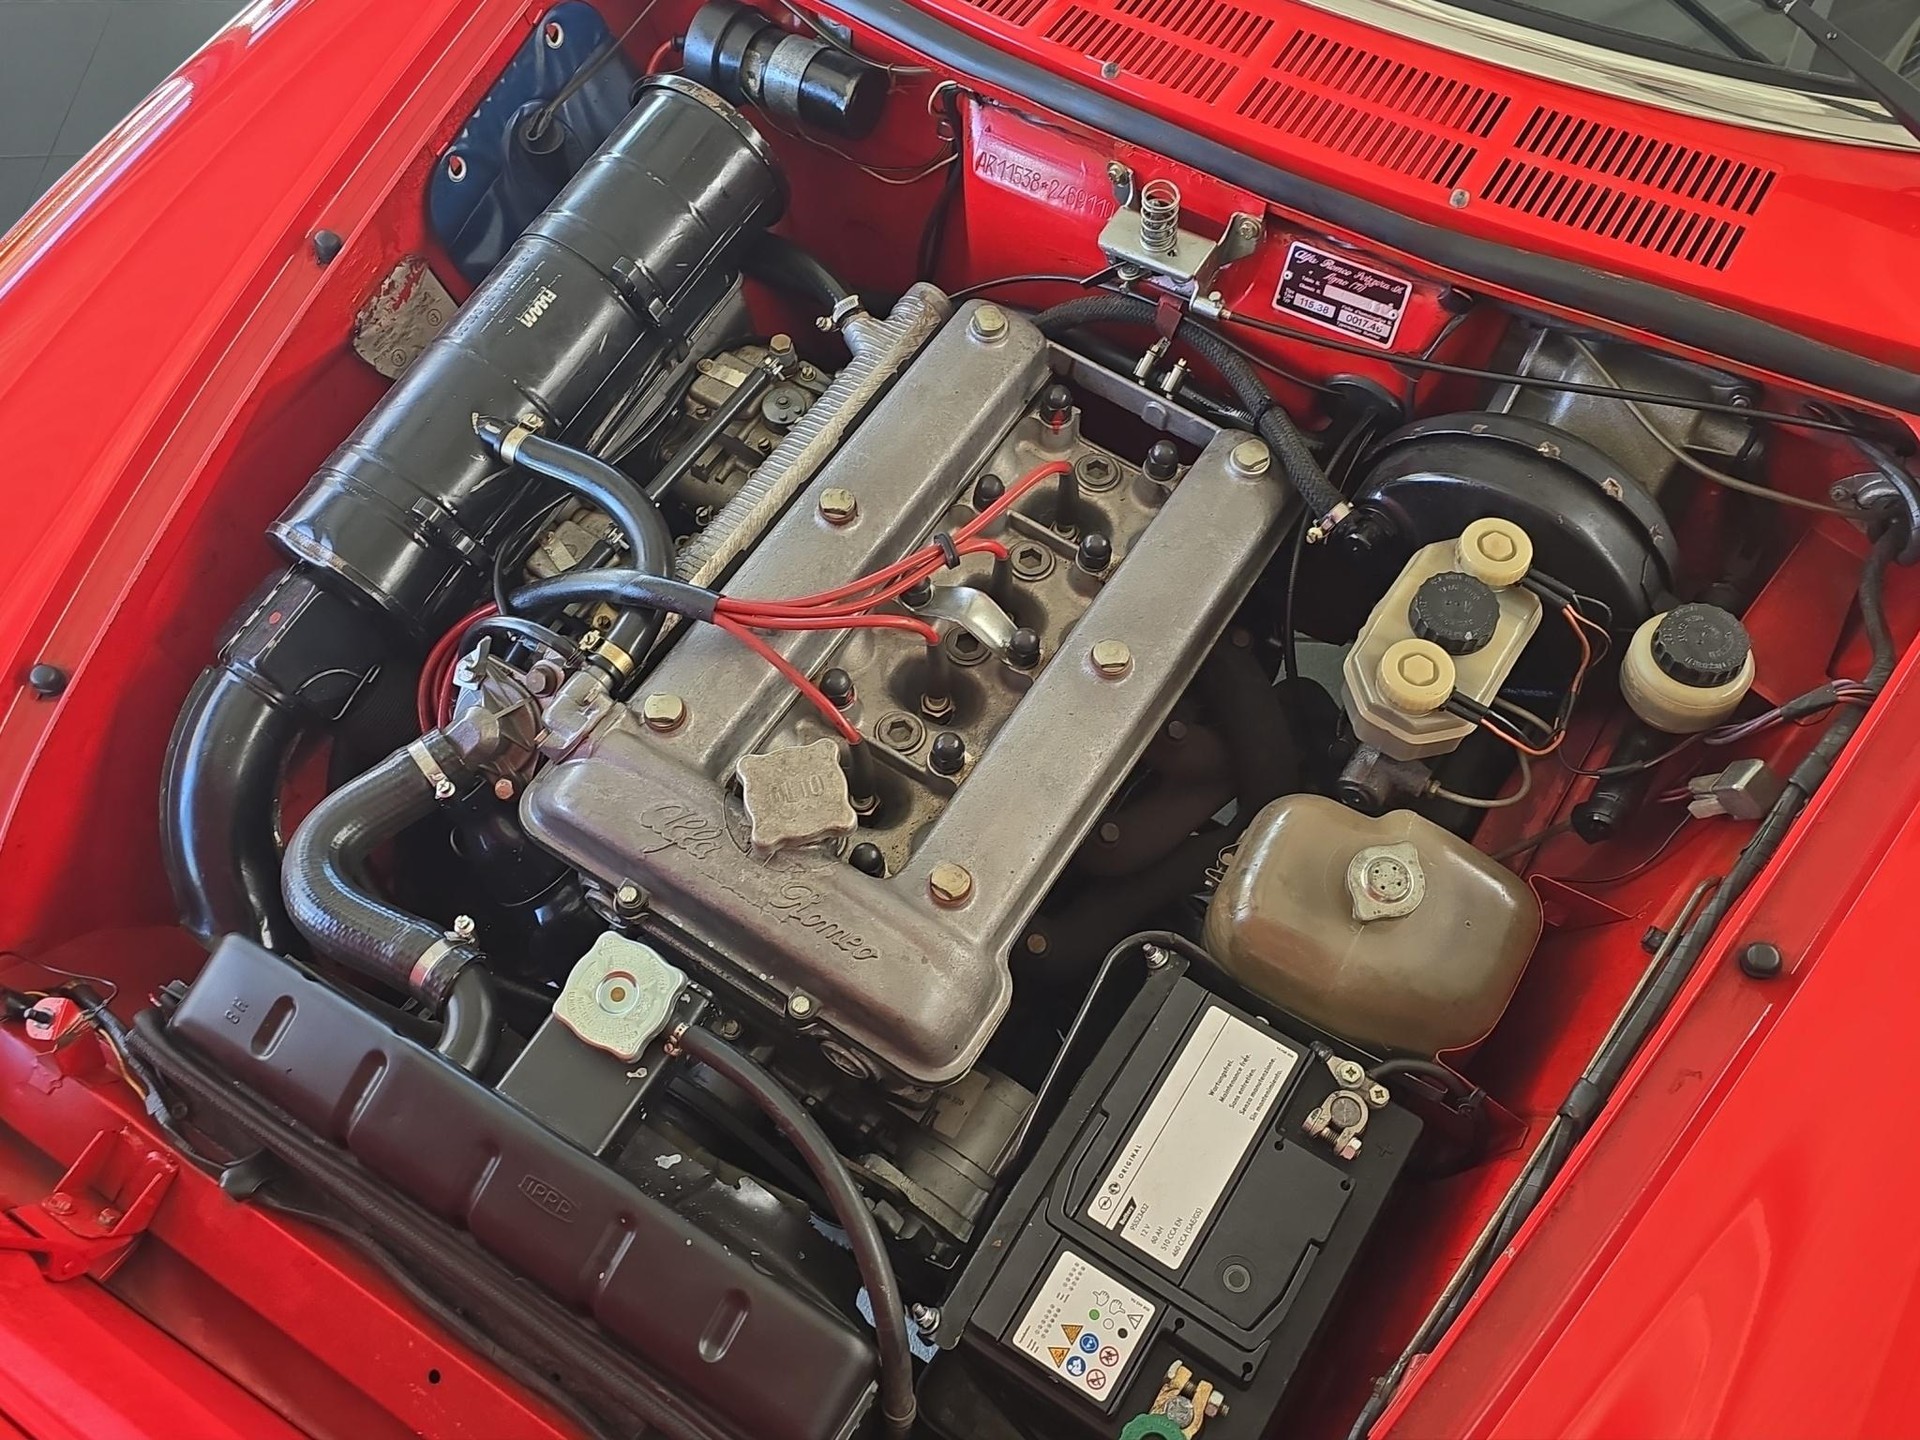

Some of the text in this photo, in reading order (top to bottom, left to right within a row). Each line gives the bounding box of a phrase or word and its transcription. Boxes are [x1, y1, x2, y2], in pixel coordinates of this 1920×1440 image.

[1320, 259, 1352, 276] Romeo
[519, 287, 558, 328] FIAAM
[1300, 297, 1330, 314] 115.38
[640, 805, 879, 960] Alfa Romeo
[1208, 1059, 1234, 1097] Wartungsfrei.
[1219, 1067, 1242, 1103] Maintenance
[1229, 1095, 1240, 1109] Sans
[1239, 1097, 1253, 1115] Senza
[1250, 1112, 1258, 1121] Sin
[1118, 1144, 1142, 1179] ORIGINAL
[1140, 1229, 1148, 1237] 12
[1151, 1226, 1164, 1245] 60 AH
[1161, 1217, 1184, 1252] 510 CCA EN
[1179, 1231, 1189, 1247] CCA
